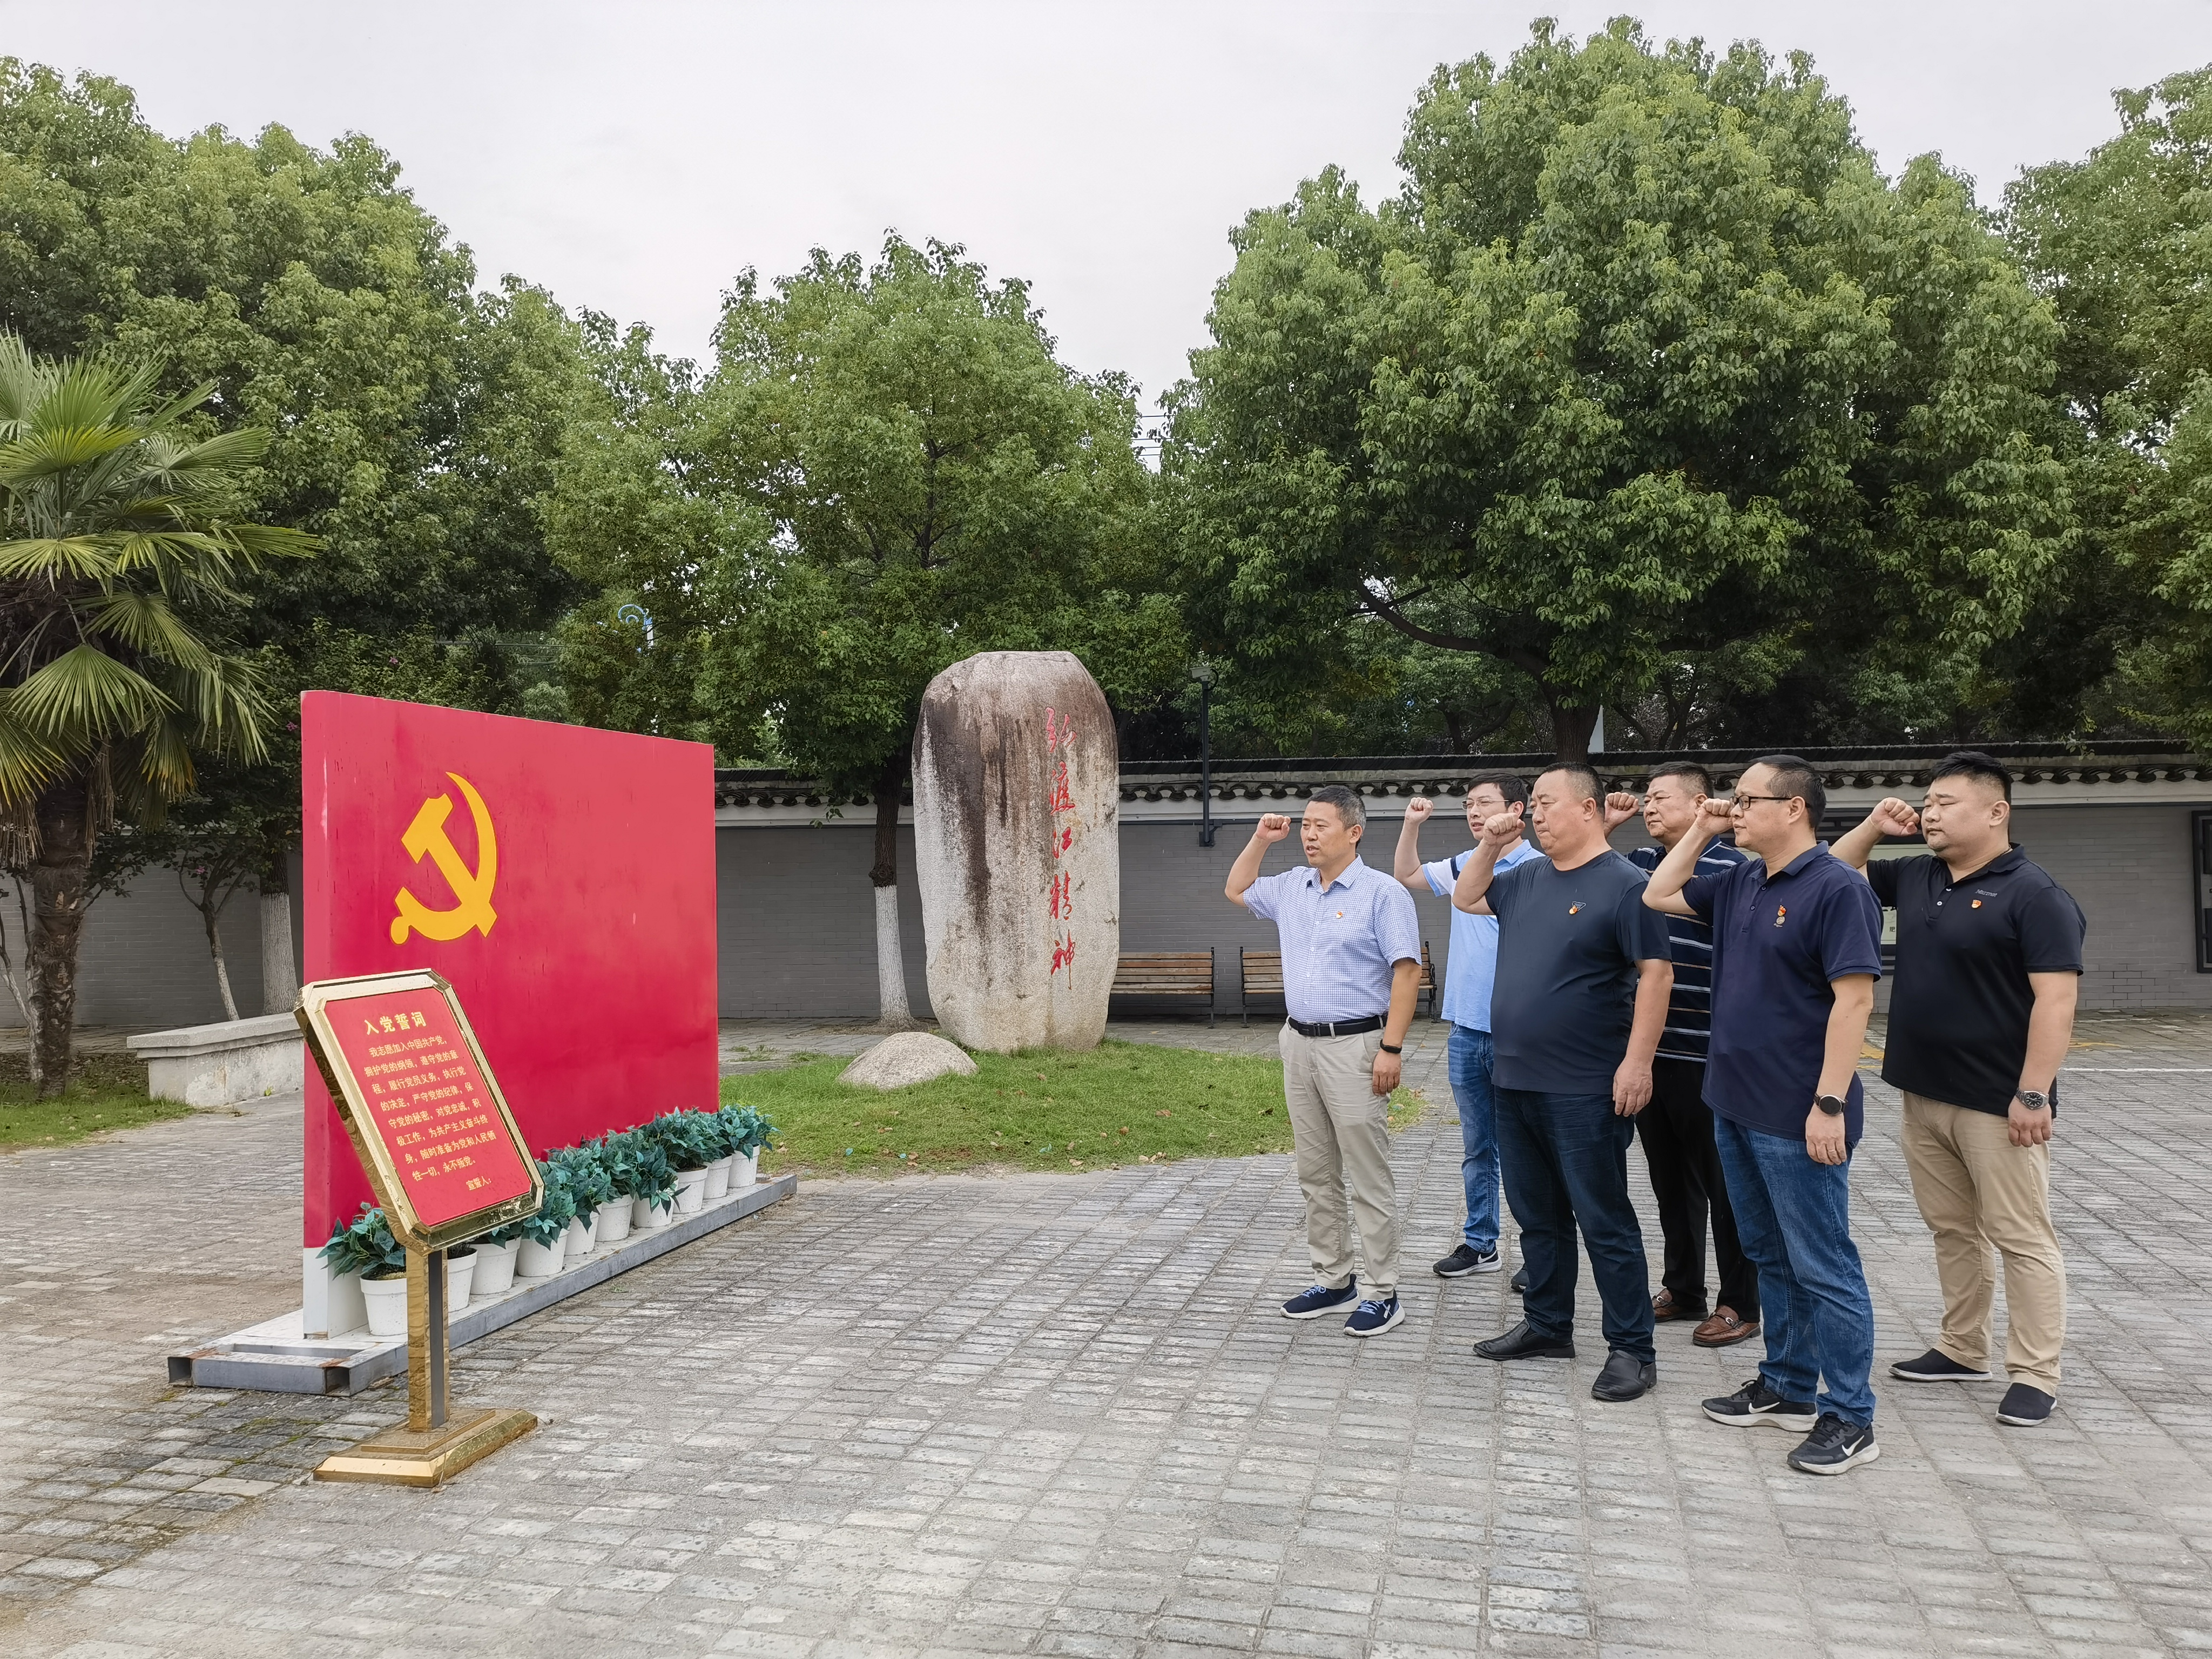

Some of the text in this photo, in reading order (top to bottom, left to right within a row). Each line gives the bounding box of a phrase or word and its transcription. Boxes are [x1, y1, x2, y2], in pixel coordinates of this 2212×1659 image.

[364, 1011, 426, 1035] 入党誓词
[368, 1035, 447, 1057] 我志愿加入中国共产党，
